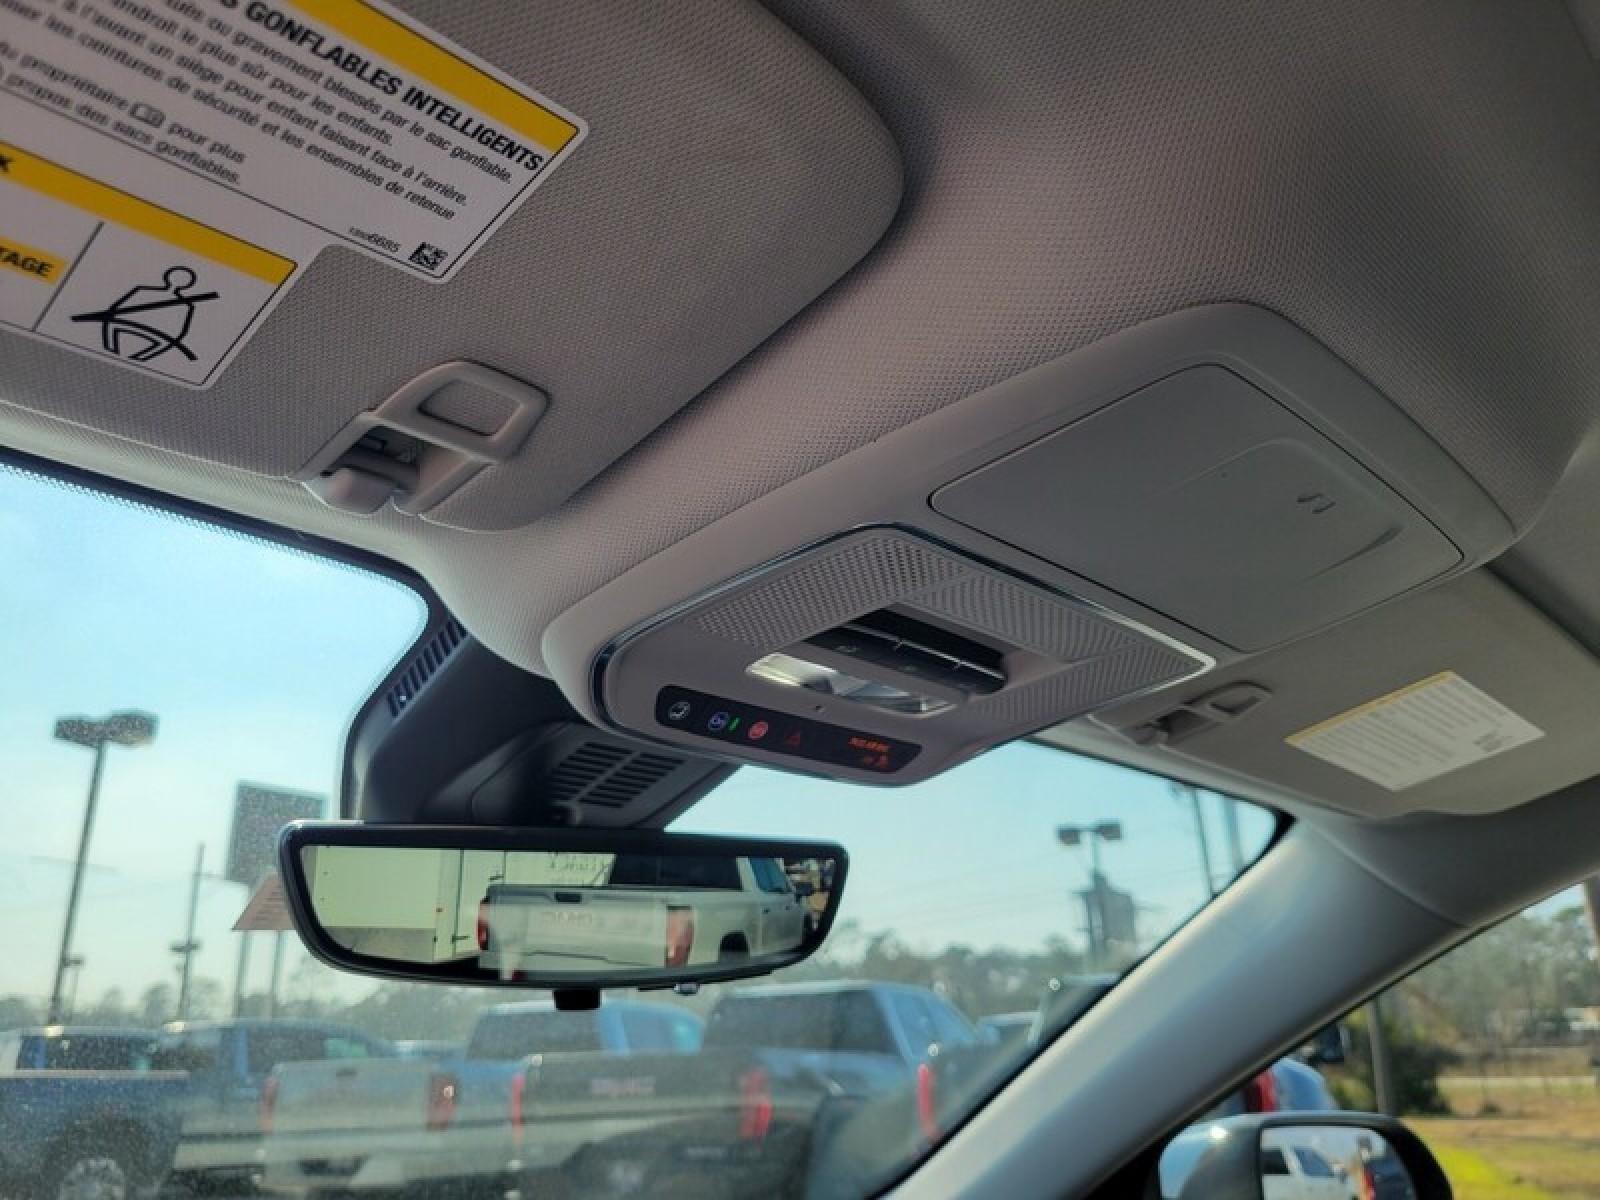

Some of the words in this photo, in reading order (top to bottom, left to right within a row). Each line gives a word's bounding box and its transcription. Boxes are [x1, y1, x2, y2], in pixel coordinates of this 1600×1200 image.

[19, 53, 128, 110] propriétaire
[167, 121, 209, 146] pour
[207, 141, 246, 164] plus
[75, 102, 109, 126] des
[111, 119, 155, 146] sacs
[77, 31, 164, 81] ceintures
[165, 75, 191, 94] de
[192, 87, 260, 127] sécurité
[261, 121, 281, 137] et
[280, 128, 305, 150] les
[305, 143, 385, 187] ensembles
[385, 181, 405, 196] de
[404, 191, 455, 220] retenue
[147, 41, 175, 61] un
[175, 55, 224, 85] siège
[223, 79, 265, 104] pour
[265, 100, 319, 132] enfant
[318, 123, 371, 158] faisant
[371, 149, 403, 173] face
[180, 27, 199, 46] le
[199, 40, 238, 67] plus
[268, 77, 309, 101] pour
[310, 95, 336, 116] les
[206, 17, 232, 36] ou
[231, 31, 323, 84] gravement
[323, 76, 382, 115] blessés
[381, 110, 410, 129] par
[408, 121, 425, 137] le
[424, 131, 452, 151] sac
[245, 1, 402, 95] GONFLABLES
[402, 86, 544, 171] INTELLIGENTS
